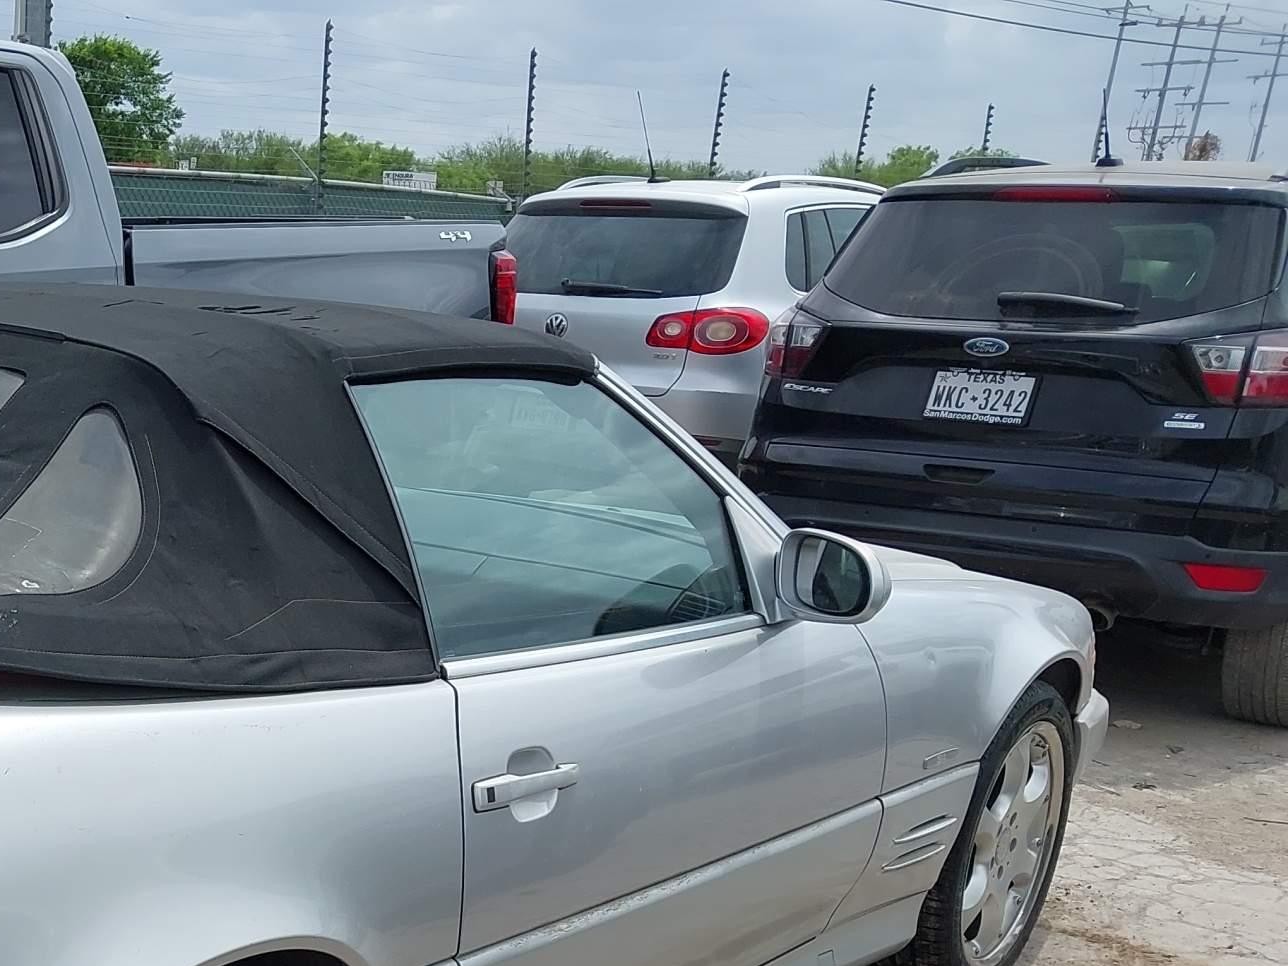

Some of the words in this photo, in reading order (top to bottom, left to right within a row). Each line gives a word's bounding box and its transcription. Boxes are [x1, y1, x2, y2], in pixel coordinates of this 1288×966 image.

[973, 341, 999, 353] Ford
[967, 373, 1006, 384] TEXAS
[783, 383, 833, 394] ESCAPE
[923, 409, 1022, 424] SanMarcosDodge.com
[1172, 412, 1199, 420] SE
